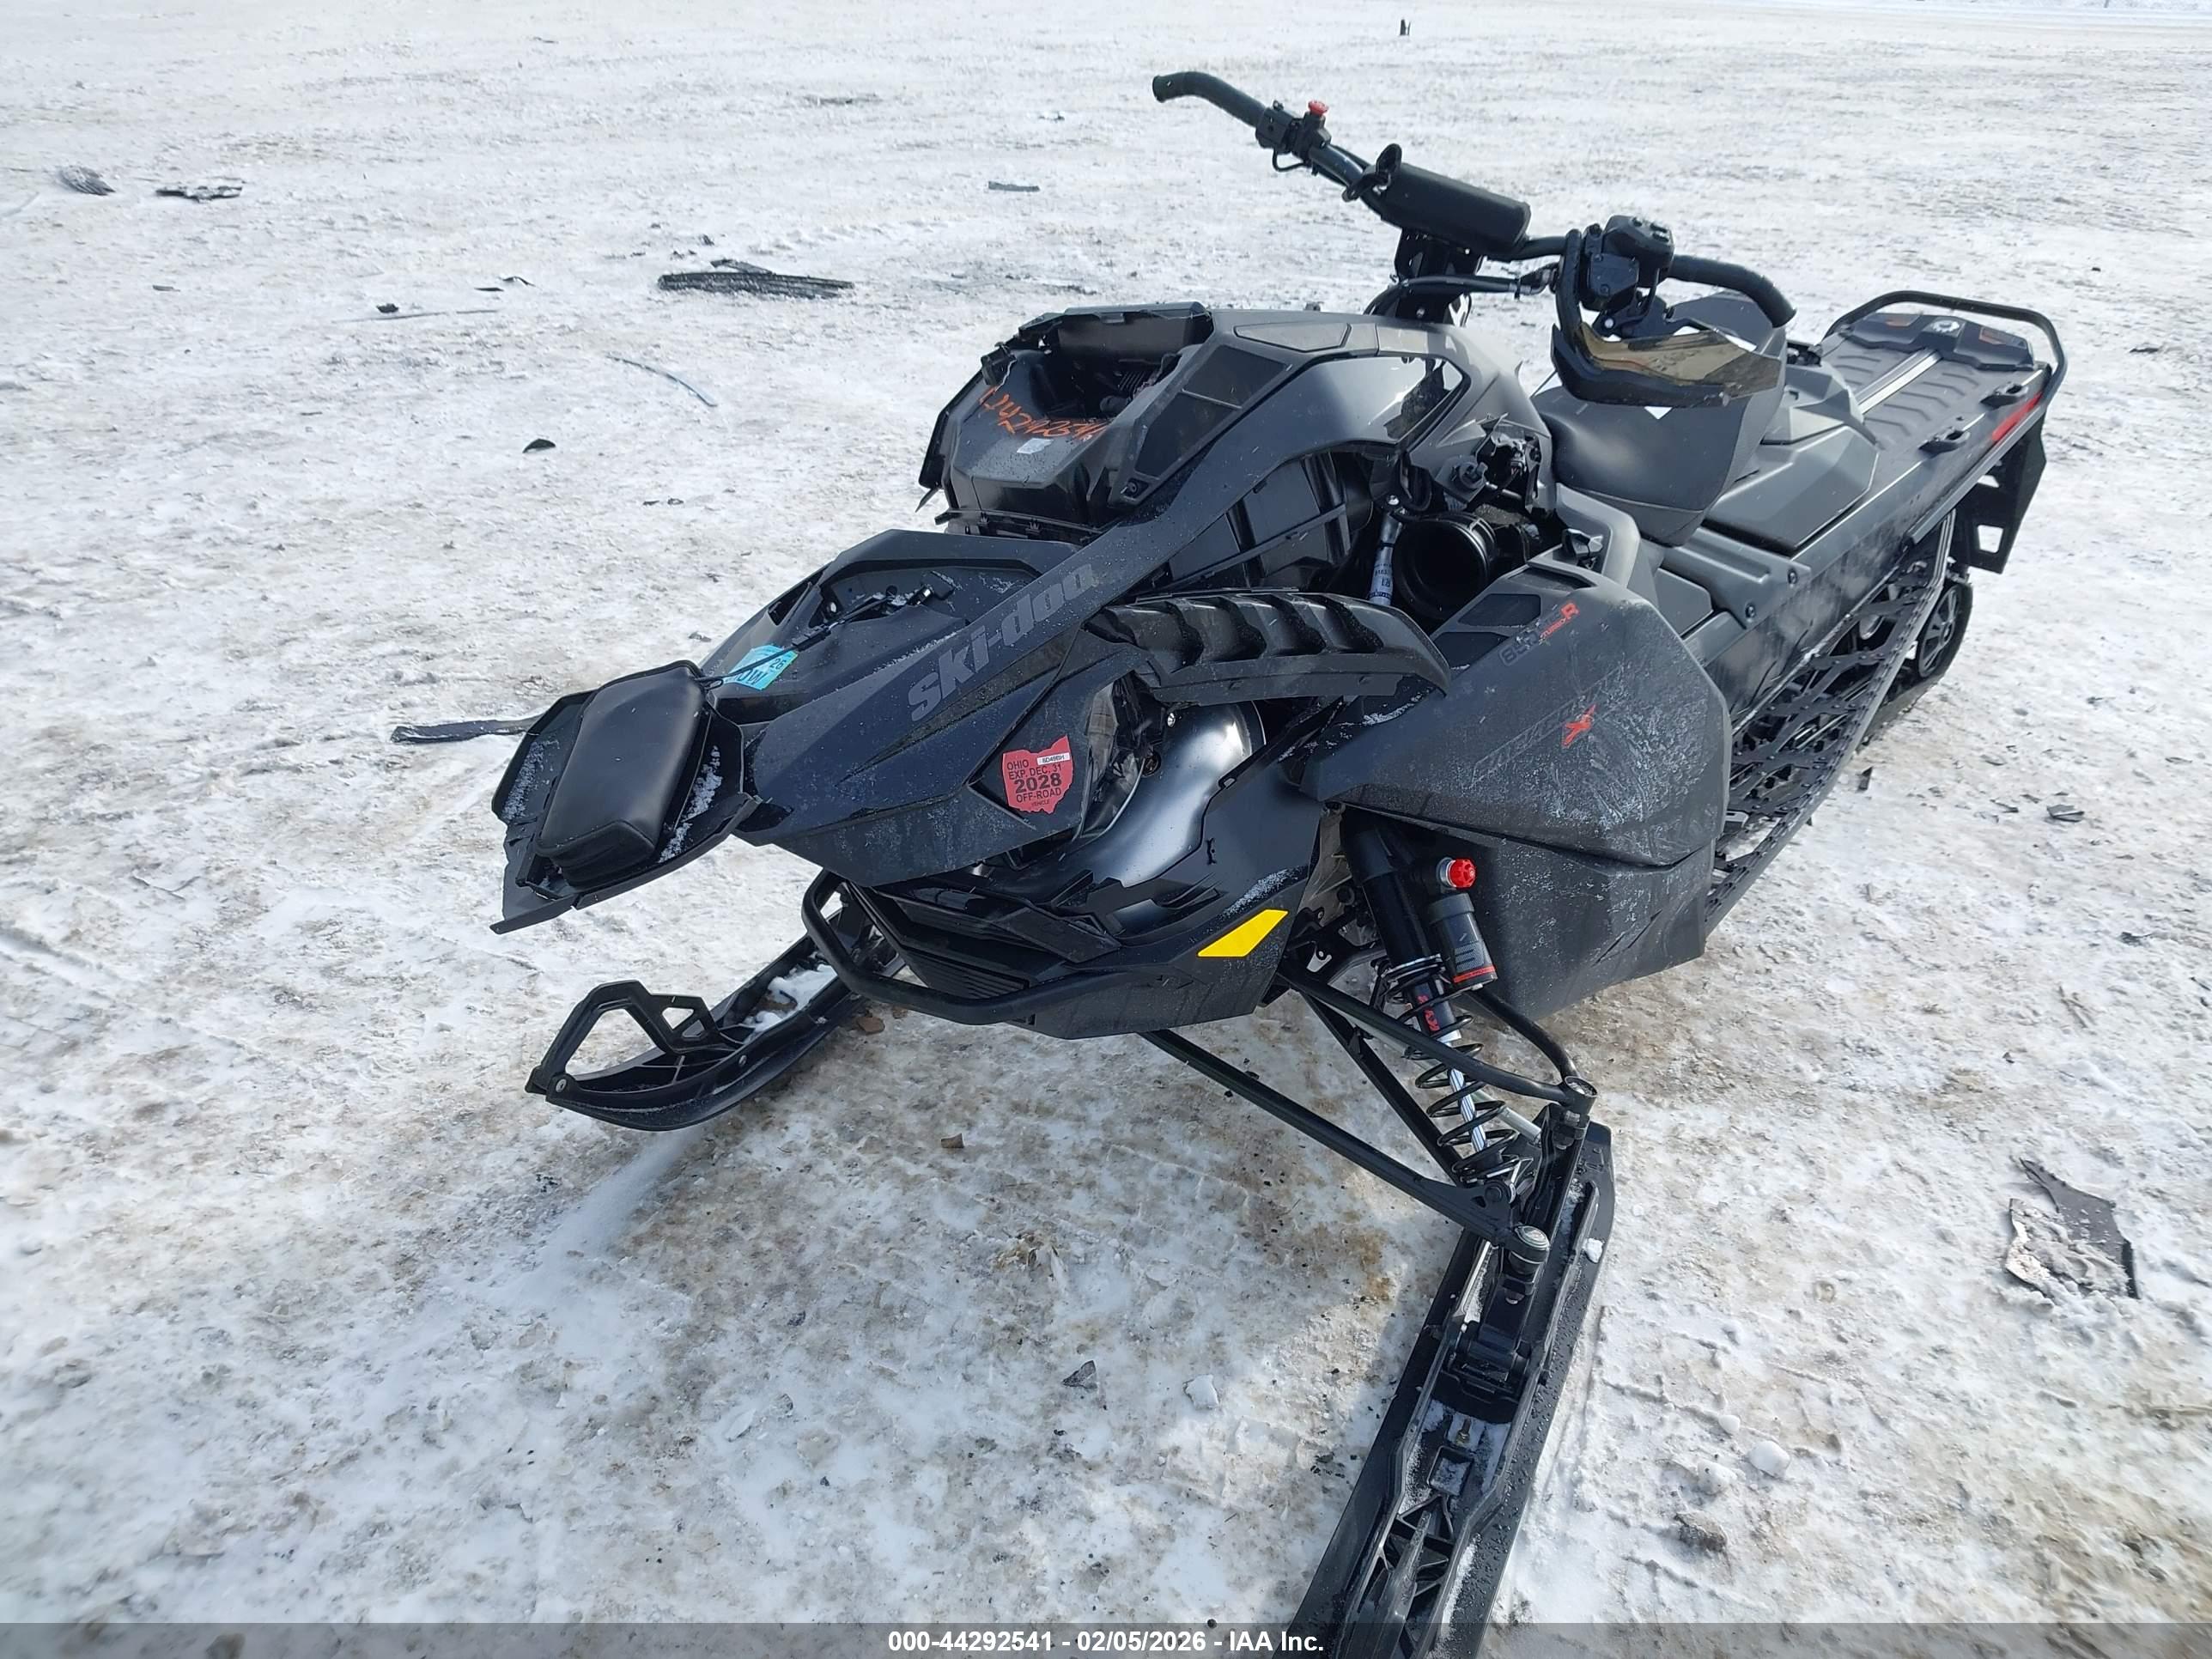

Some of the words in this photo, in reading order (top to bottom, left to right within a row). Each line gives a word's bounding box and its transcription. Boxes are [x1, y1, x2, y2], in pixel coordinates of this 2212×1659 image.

[1007, 760, 1030, 770] OHIO
[1008, 769, 1028, 780] EXP.
[1014, 773, 1062, 793] 2028
[1016, 787, 1062, 803] OFF-ROAD
